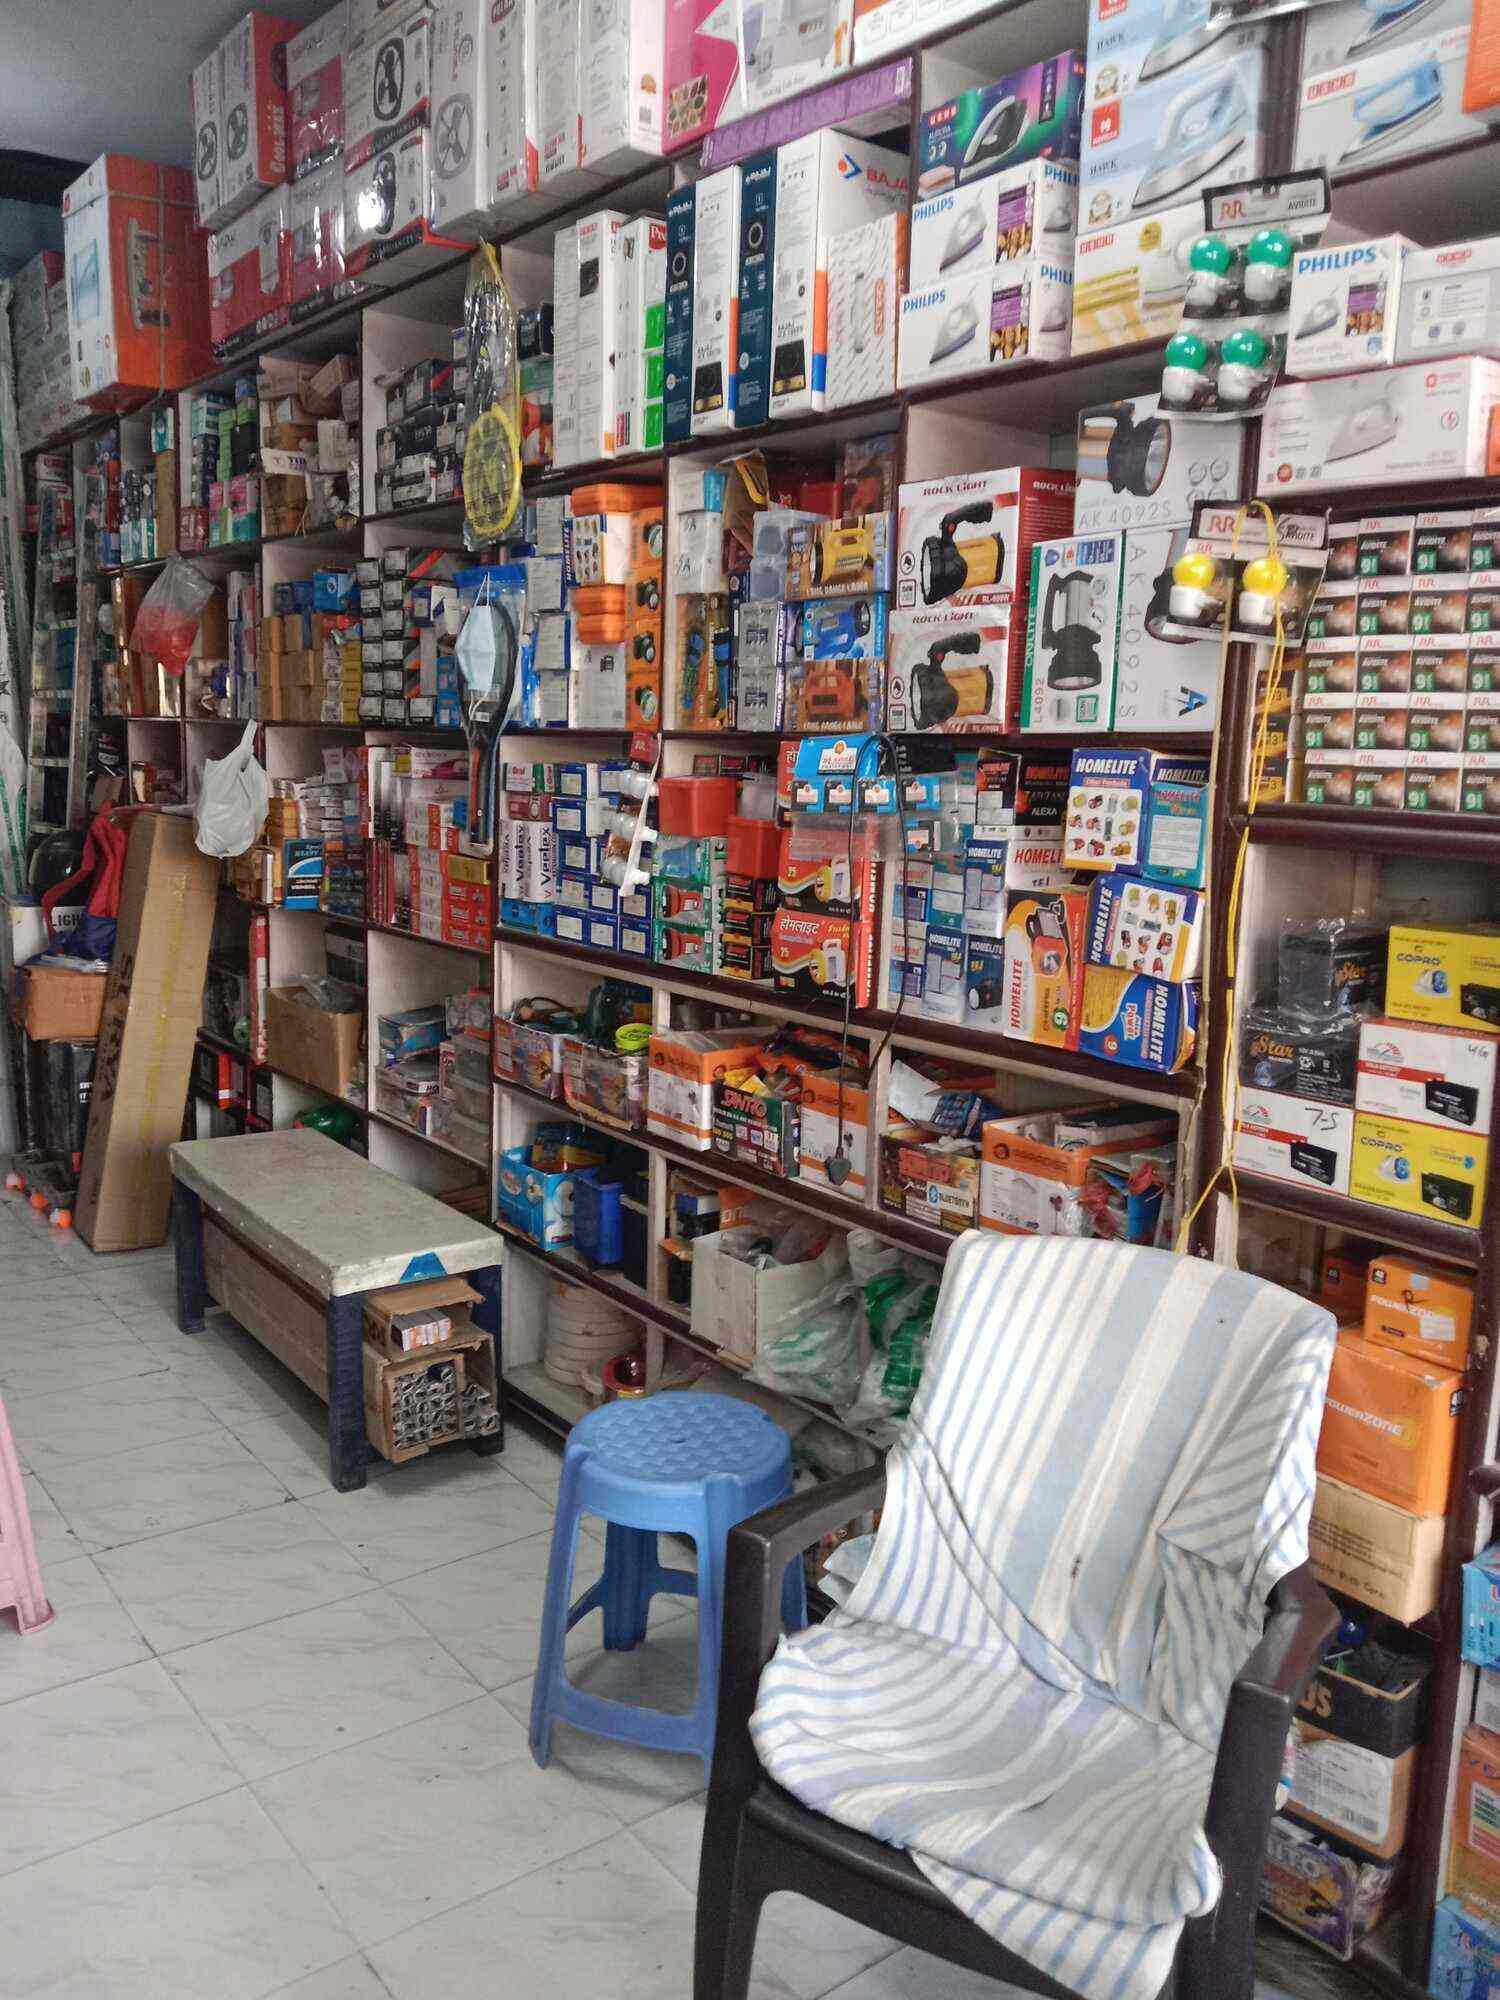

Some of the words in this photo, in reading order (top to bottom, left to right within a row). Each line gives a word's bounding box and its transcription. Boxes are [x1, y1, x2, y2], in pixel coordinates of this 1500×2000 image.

[913, 196, 955, 223] PHILIPS
[1298, 246, 1377, 274] PHILIPS
[1039, 265, 1072, 286] PHILI
[903, 290, 946, 313] PHILIPS
[912, 614, 943, 626] ROCK
[1075, 757, 1138, 775] HOMELITE
[1014, 847, 1064, 865] HOMELI
[1091, 886, 1113, 963] HOMELITE
[1010, 959, 1025, 1029] HOMELITE
[1149, 983, 1169, 1063] HOMELITE
